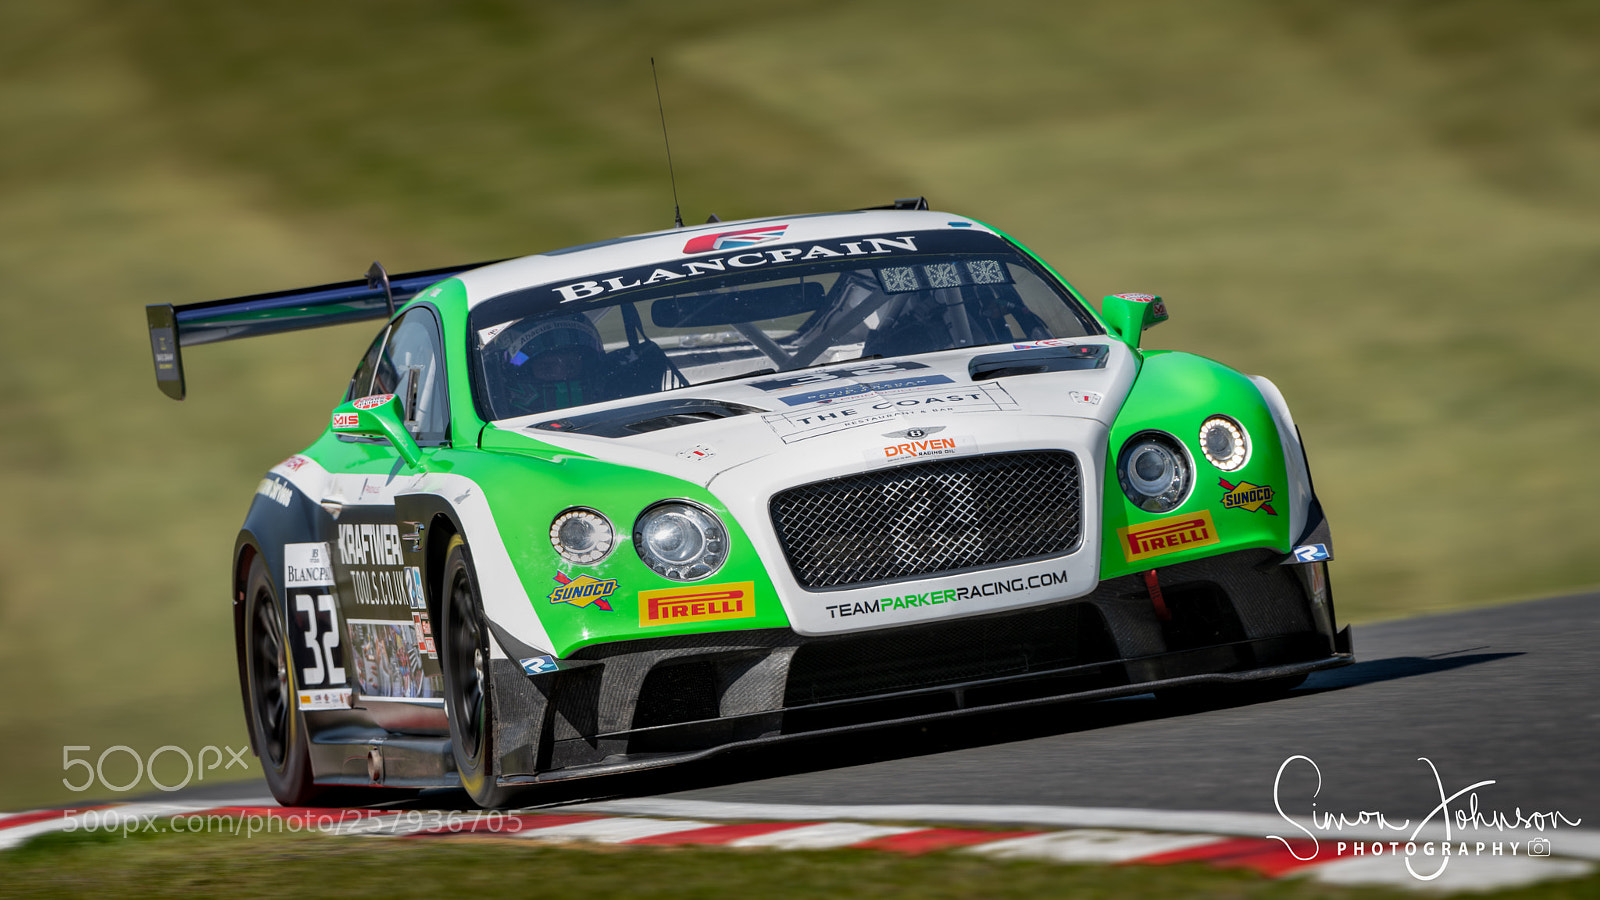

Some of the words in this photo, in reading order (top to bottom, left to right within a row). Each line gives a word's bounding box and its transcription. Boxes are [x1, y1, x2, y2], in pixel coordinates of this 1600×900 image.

[552, 236, 918, 304] BLANCPAIN
[796, 407, 858, 426] THE
[872, 392, 981, 411] COAST
[884, 438, 956, 458] DRIVEN
[918, 449, 943, 457] RACING
[1225, 486, 1273, 507] SUNOCO
[1128, 518, 1209, 556] PIRELLI
[350, 570, 409, 606] TOOLS.CO.UK
[553, 579, 617, 604] SUNOCO
[826, 570, 1068, 620] TEAMPARKERRACING.COM
[648, 590, 743, 621] PIRELLI
[295, 594, 346, 685] 32
